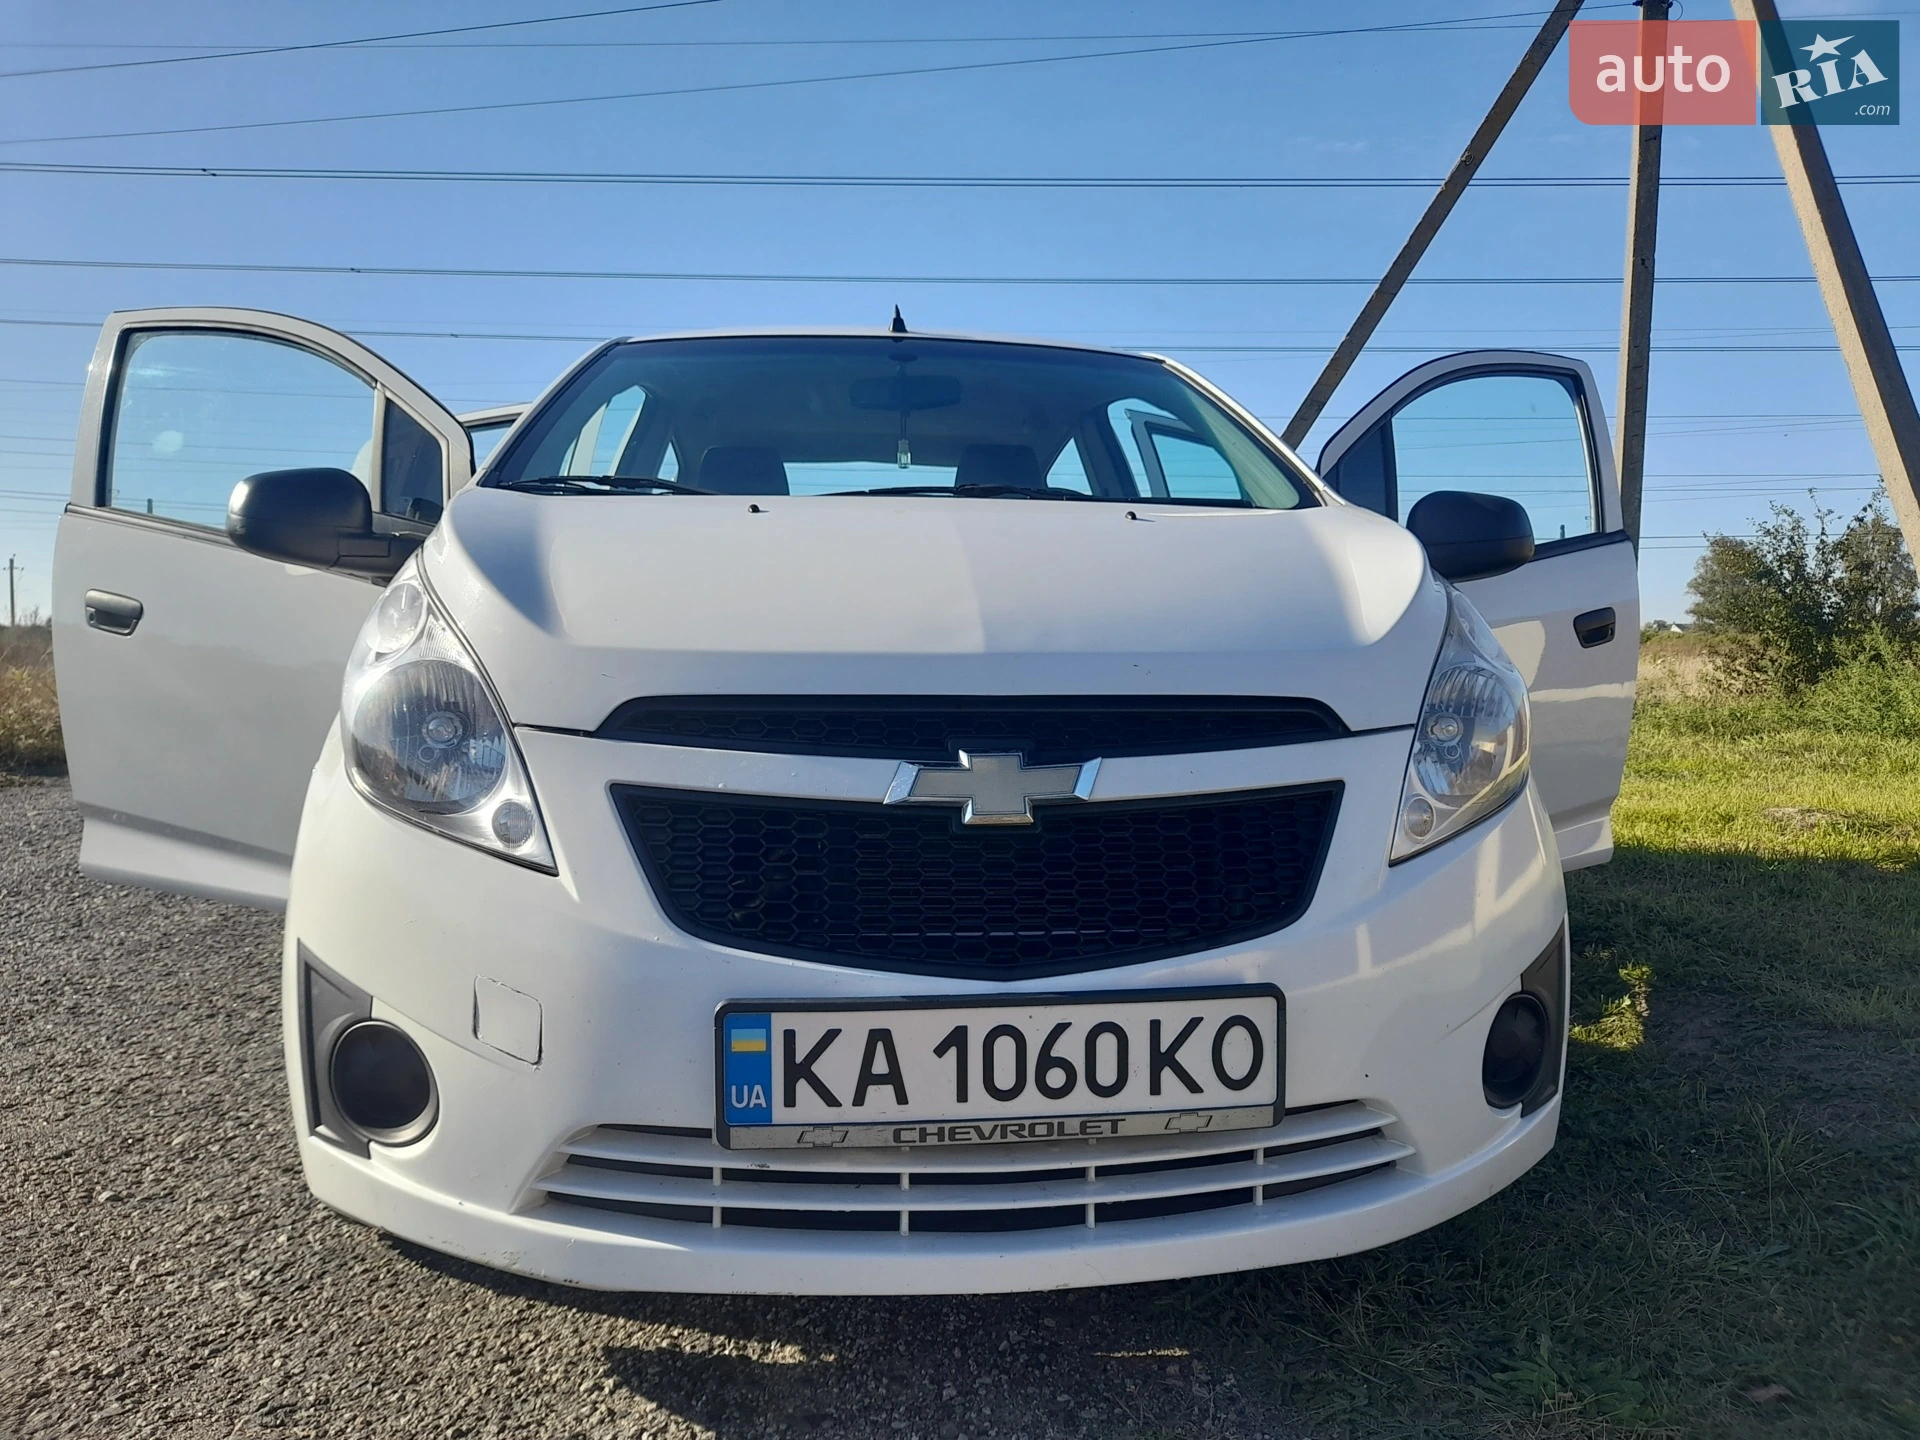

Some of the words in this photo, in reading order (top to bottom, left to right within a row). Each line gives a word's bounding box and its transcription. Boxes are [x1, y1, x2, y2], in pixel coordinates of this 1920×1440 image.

[782, 1028, 909, 1108] KA
[932, 1020, 1129, 1103] 1060
[1148, 1014, 1264, 1096] KO
[730, 1085, 768, 1109] UA
[892, 1117, 1127, 1144] CHEVROLET
